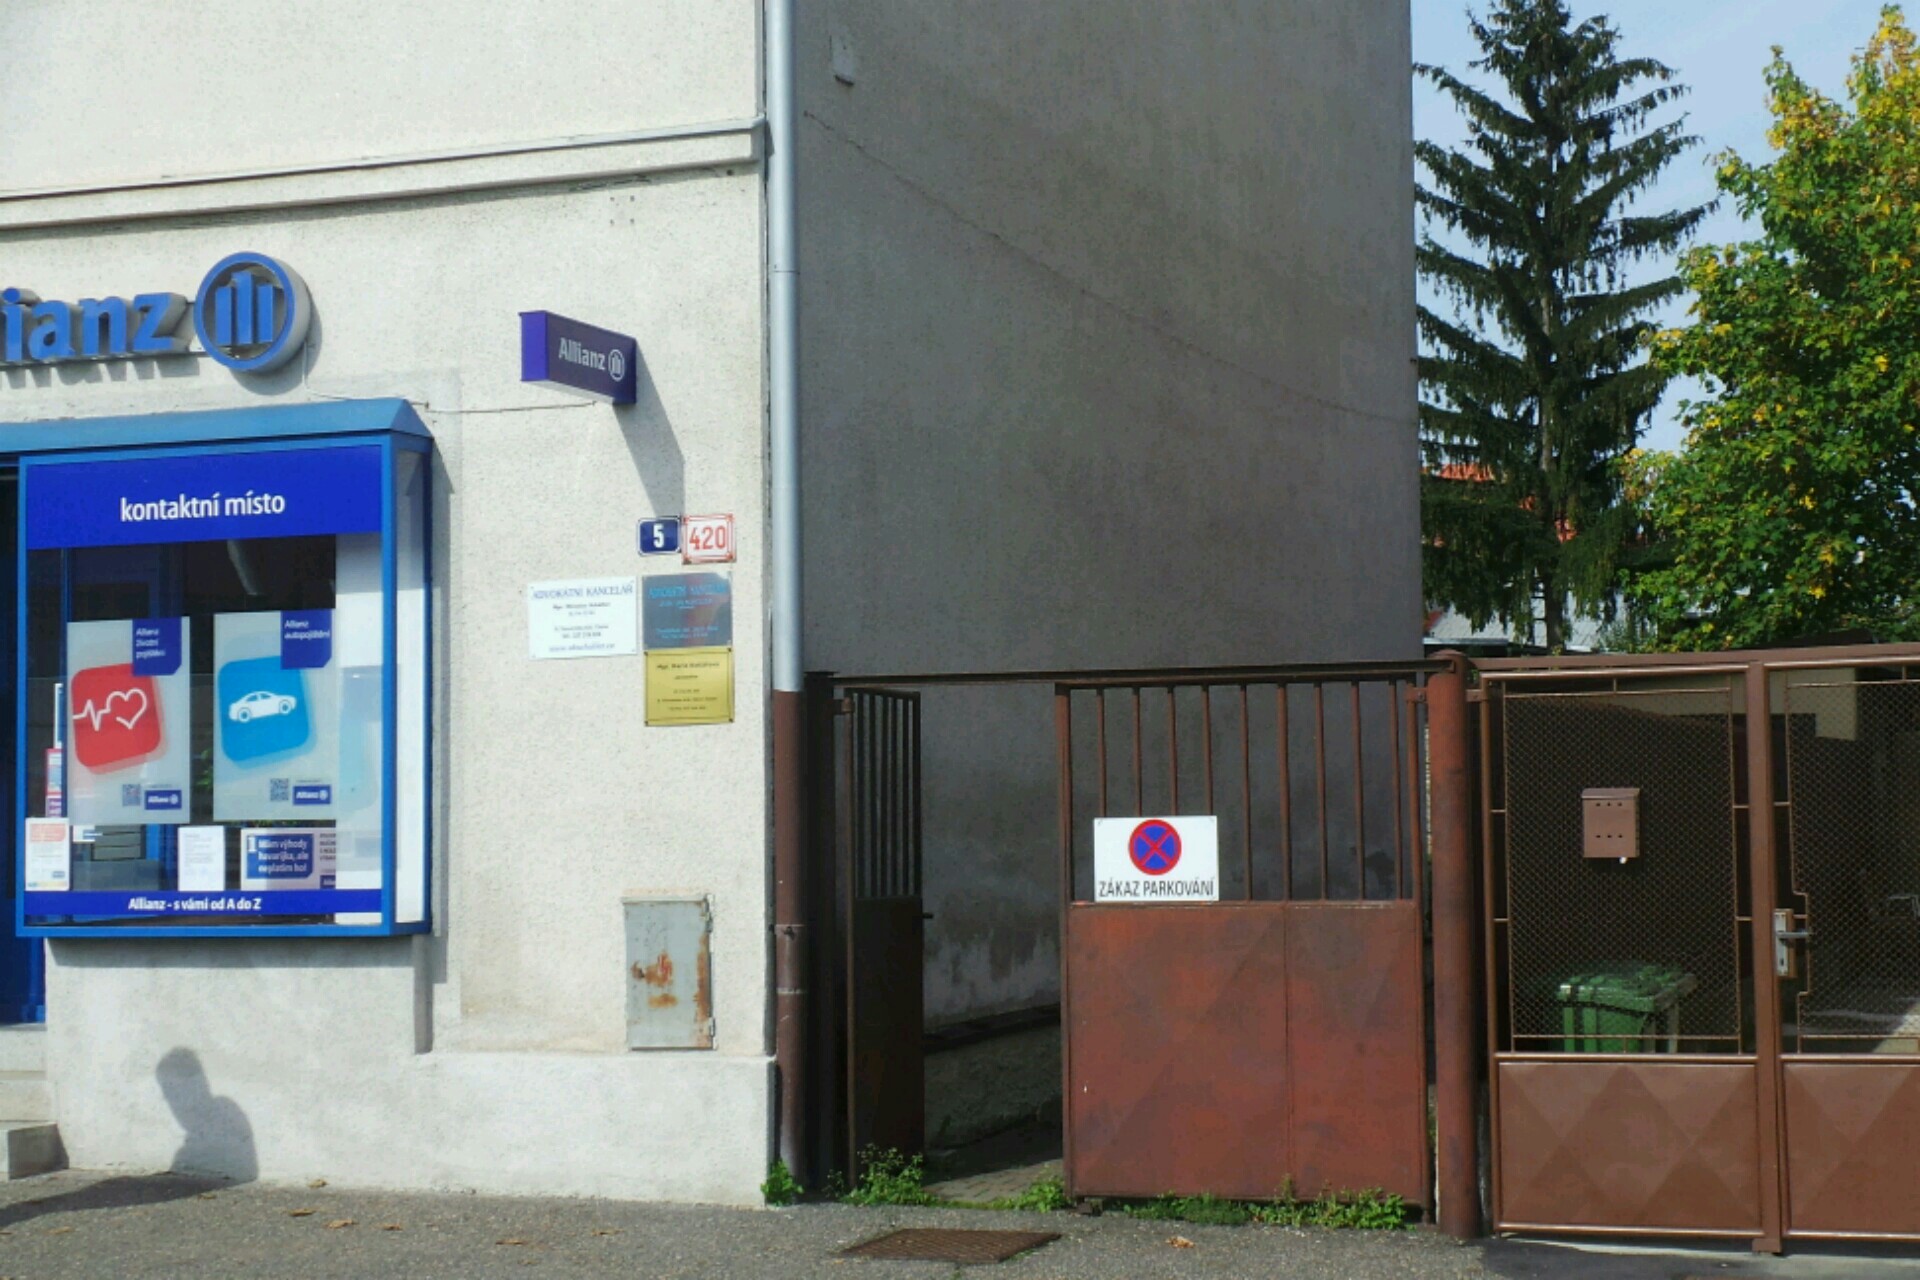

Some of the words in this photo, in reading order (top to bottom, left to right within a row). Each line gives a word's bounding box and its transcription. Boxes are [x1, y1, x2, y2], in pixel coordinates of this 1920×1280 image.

[0, 287, 175, 362] ianz
[558, 337, 606, 370] Allianz
[120, 491, 221, 522] kontaktní
[224, 490, 286, 516] místo
[653, 523, 665, 548] 5
[689, 525, 726, 550] 420
[136, 628, 159, 636] Allianz
[284, 620, 309, 629] Allianz
[295, 791, 319, 799] Allianz
[280, 838, 308, 850] výhody
[1098, 877, 1140, 897] ZÁKAZ
[1143, 876, 1216, 897] PARKOVÁNÍ
[128, 897, 166, 910] Allianz
[173, 900, 180, 910] s
[181, 897, 208, 910] vámi
[211, 897, 225, 910] od
[226, 898, 235, 910] A
[236, 897, 251, 910] do
[252, 898, 262, 910] Z
